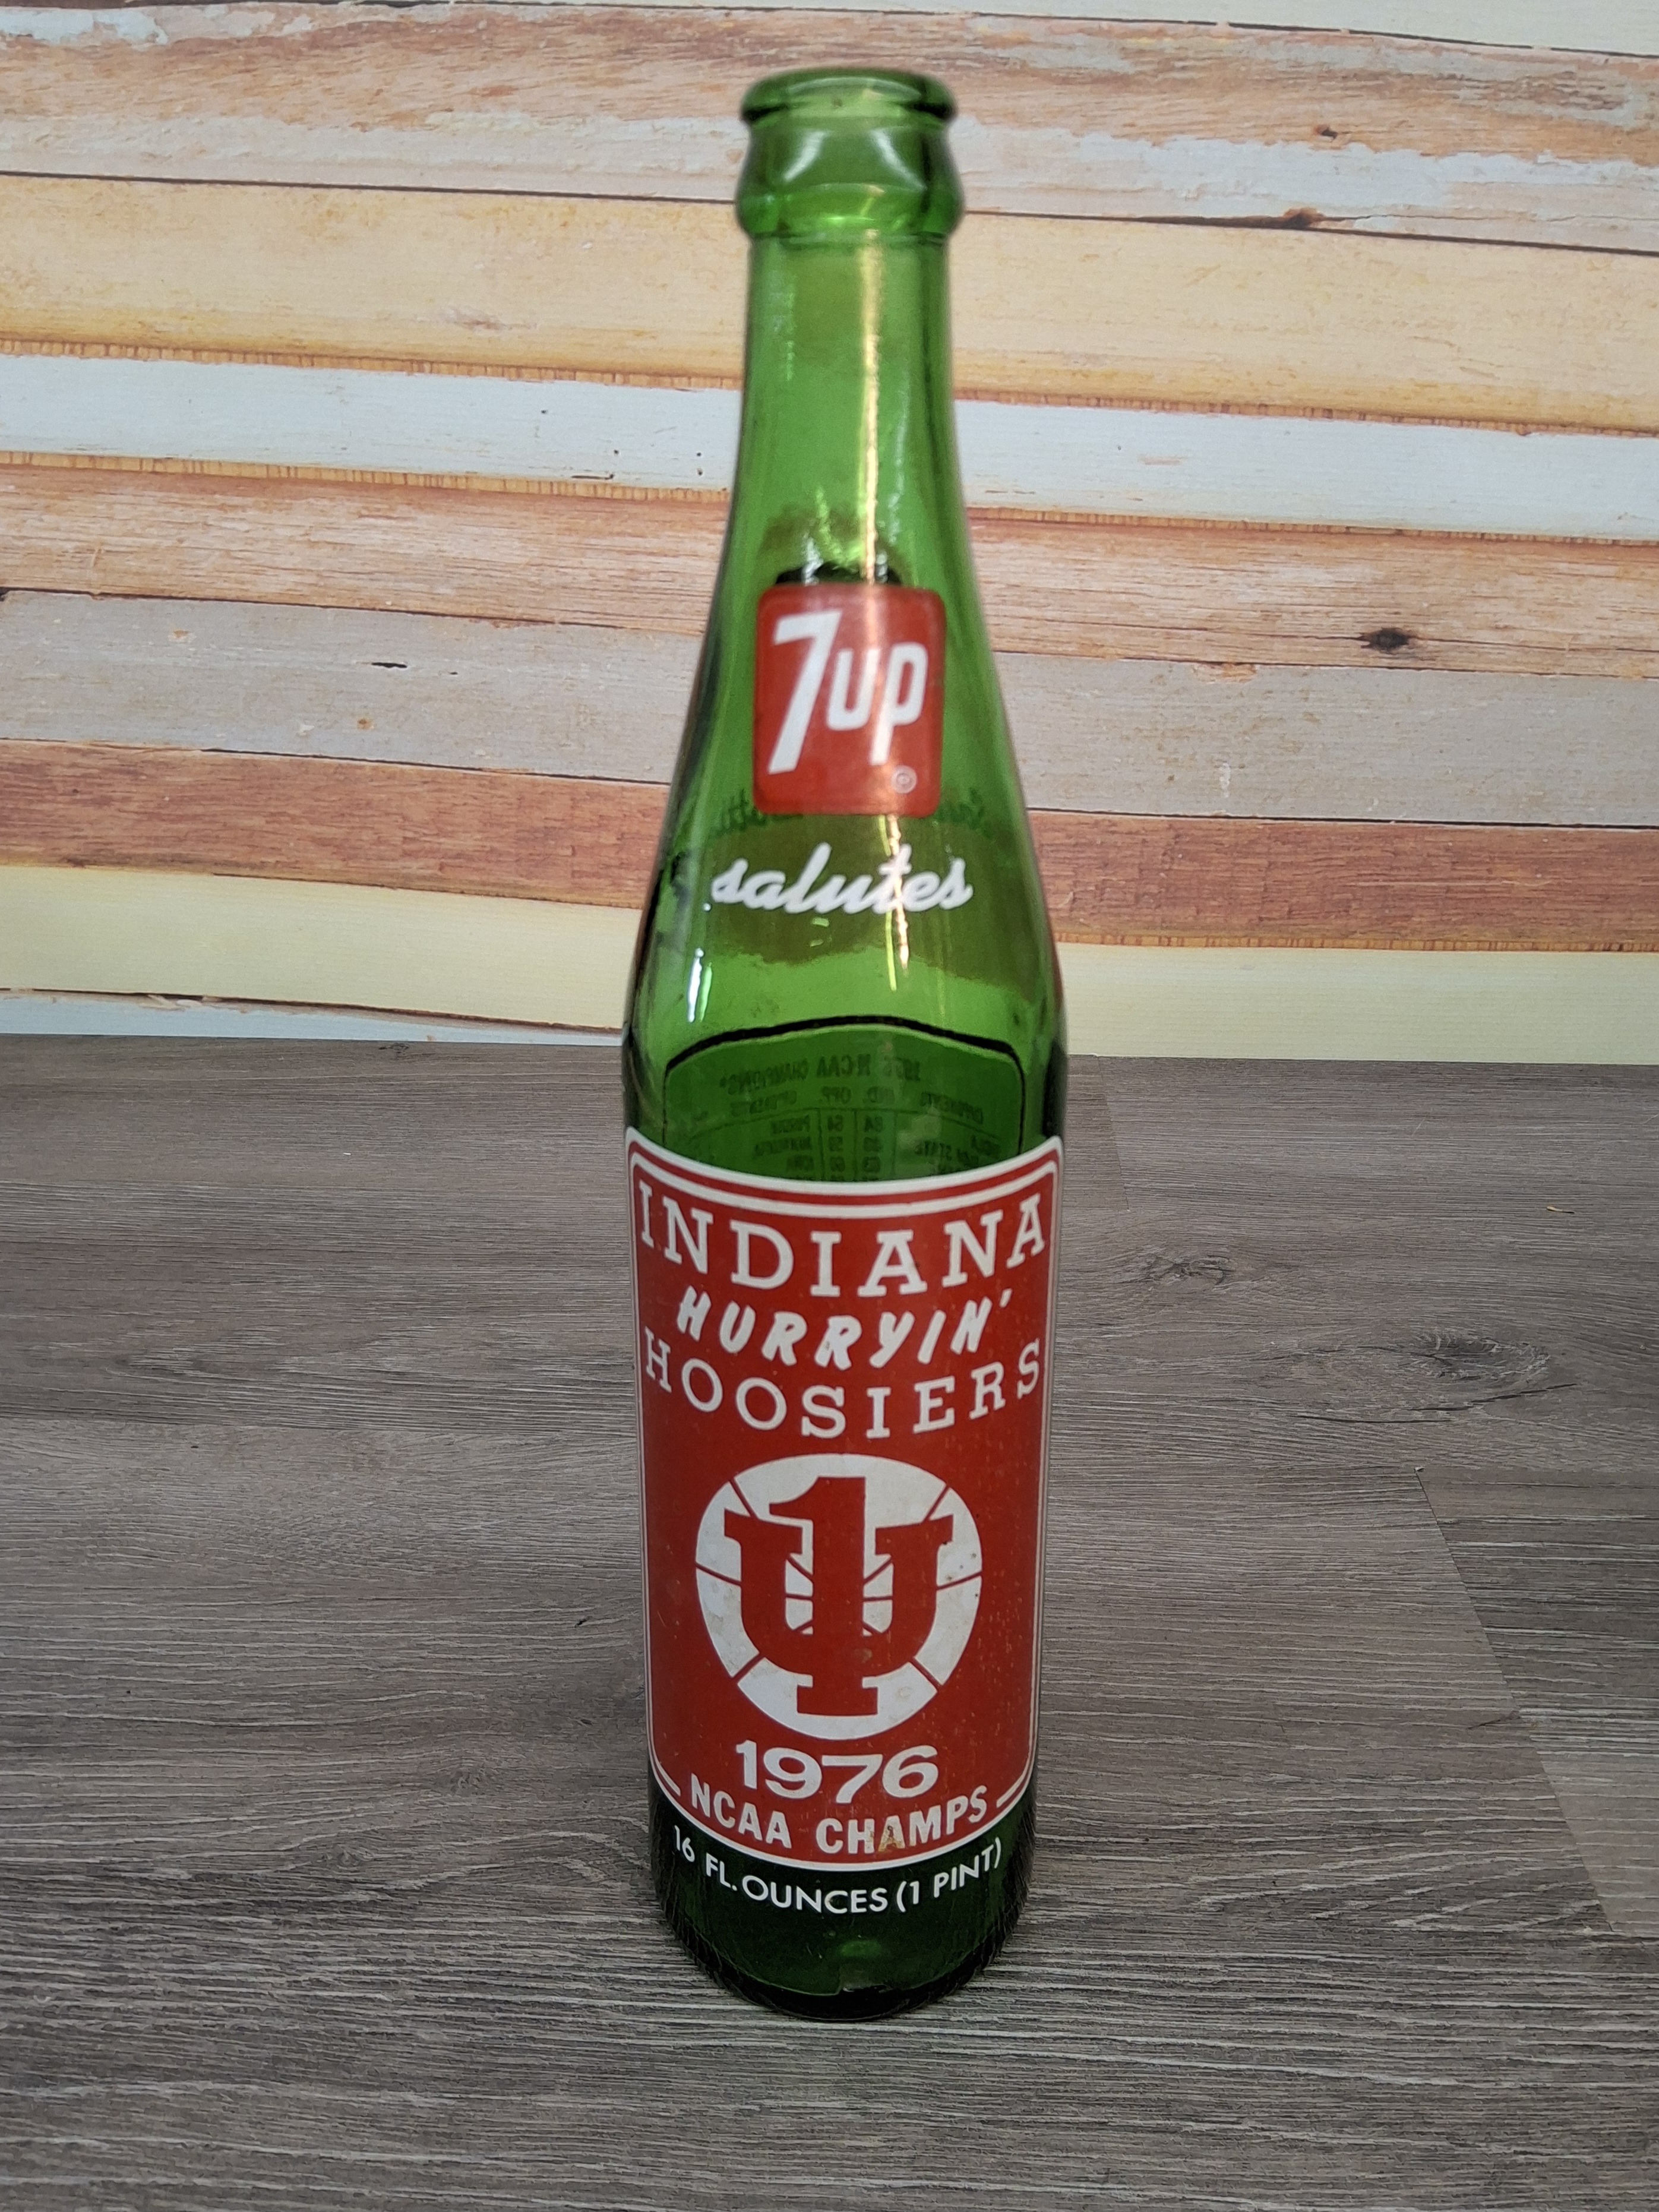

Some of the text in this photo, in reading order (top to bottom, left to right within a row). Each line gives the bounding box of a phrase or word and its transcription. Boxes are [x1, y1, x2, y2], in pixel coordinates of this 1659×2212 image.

[712, 842, 974, 914] salutes
[639, 1180, 1045, 1297] INDIANA
[677, 1285, 1013, 1371] HURRYIN'
[645, 1326, 1041, 1439] HOOSIERS
[690, 1773, 988, 1854] NCAA CHAMPS
[735, 1740, 939, 1804] 1976
[674, 1825, 696, 1863] 16
[896, 1880, 920, 1913] (1
[933, 1837, 1002, 1899] PINT)
